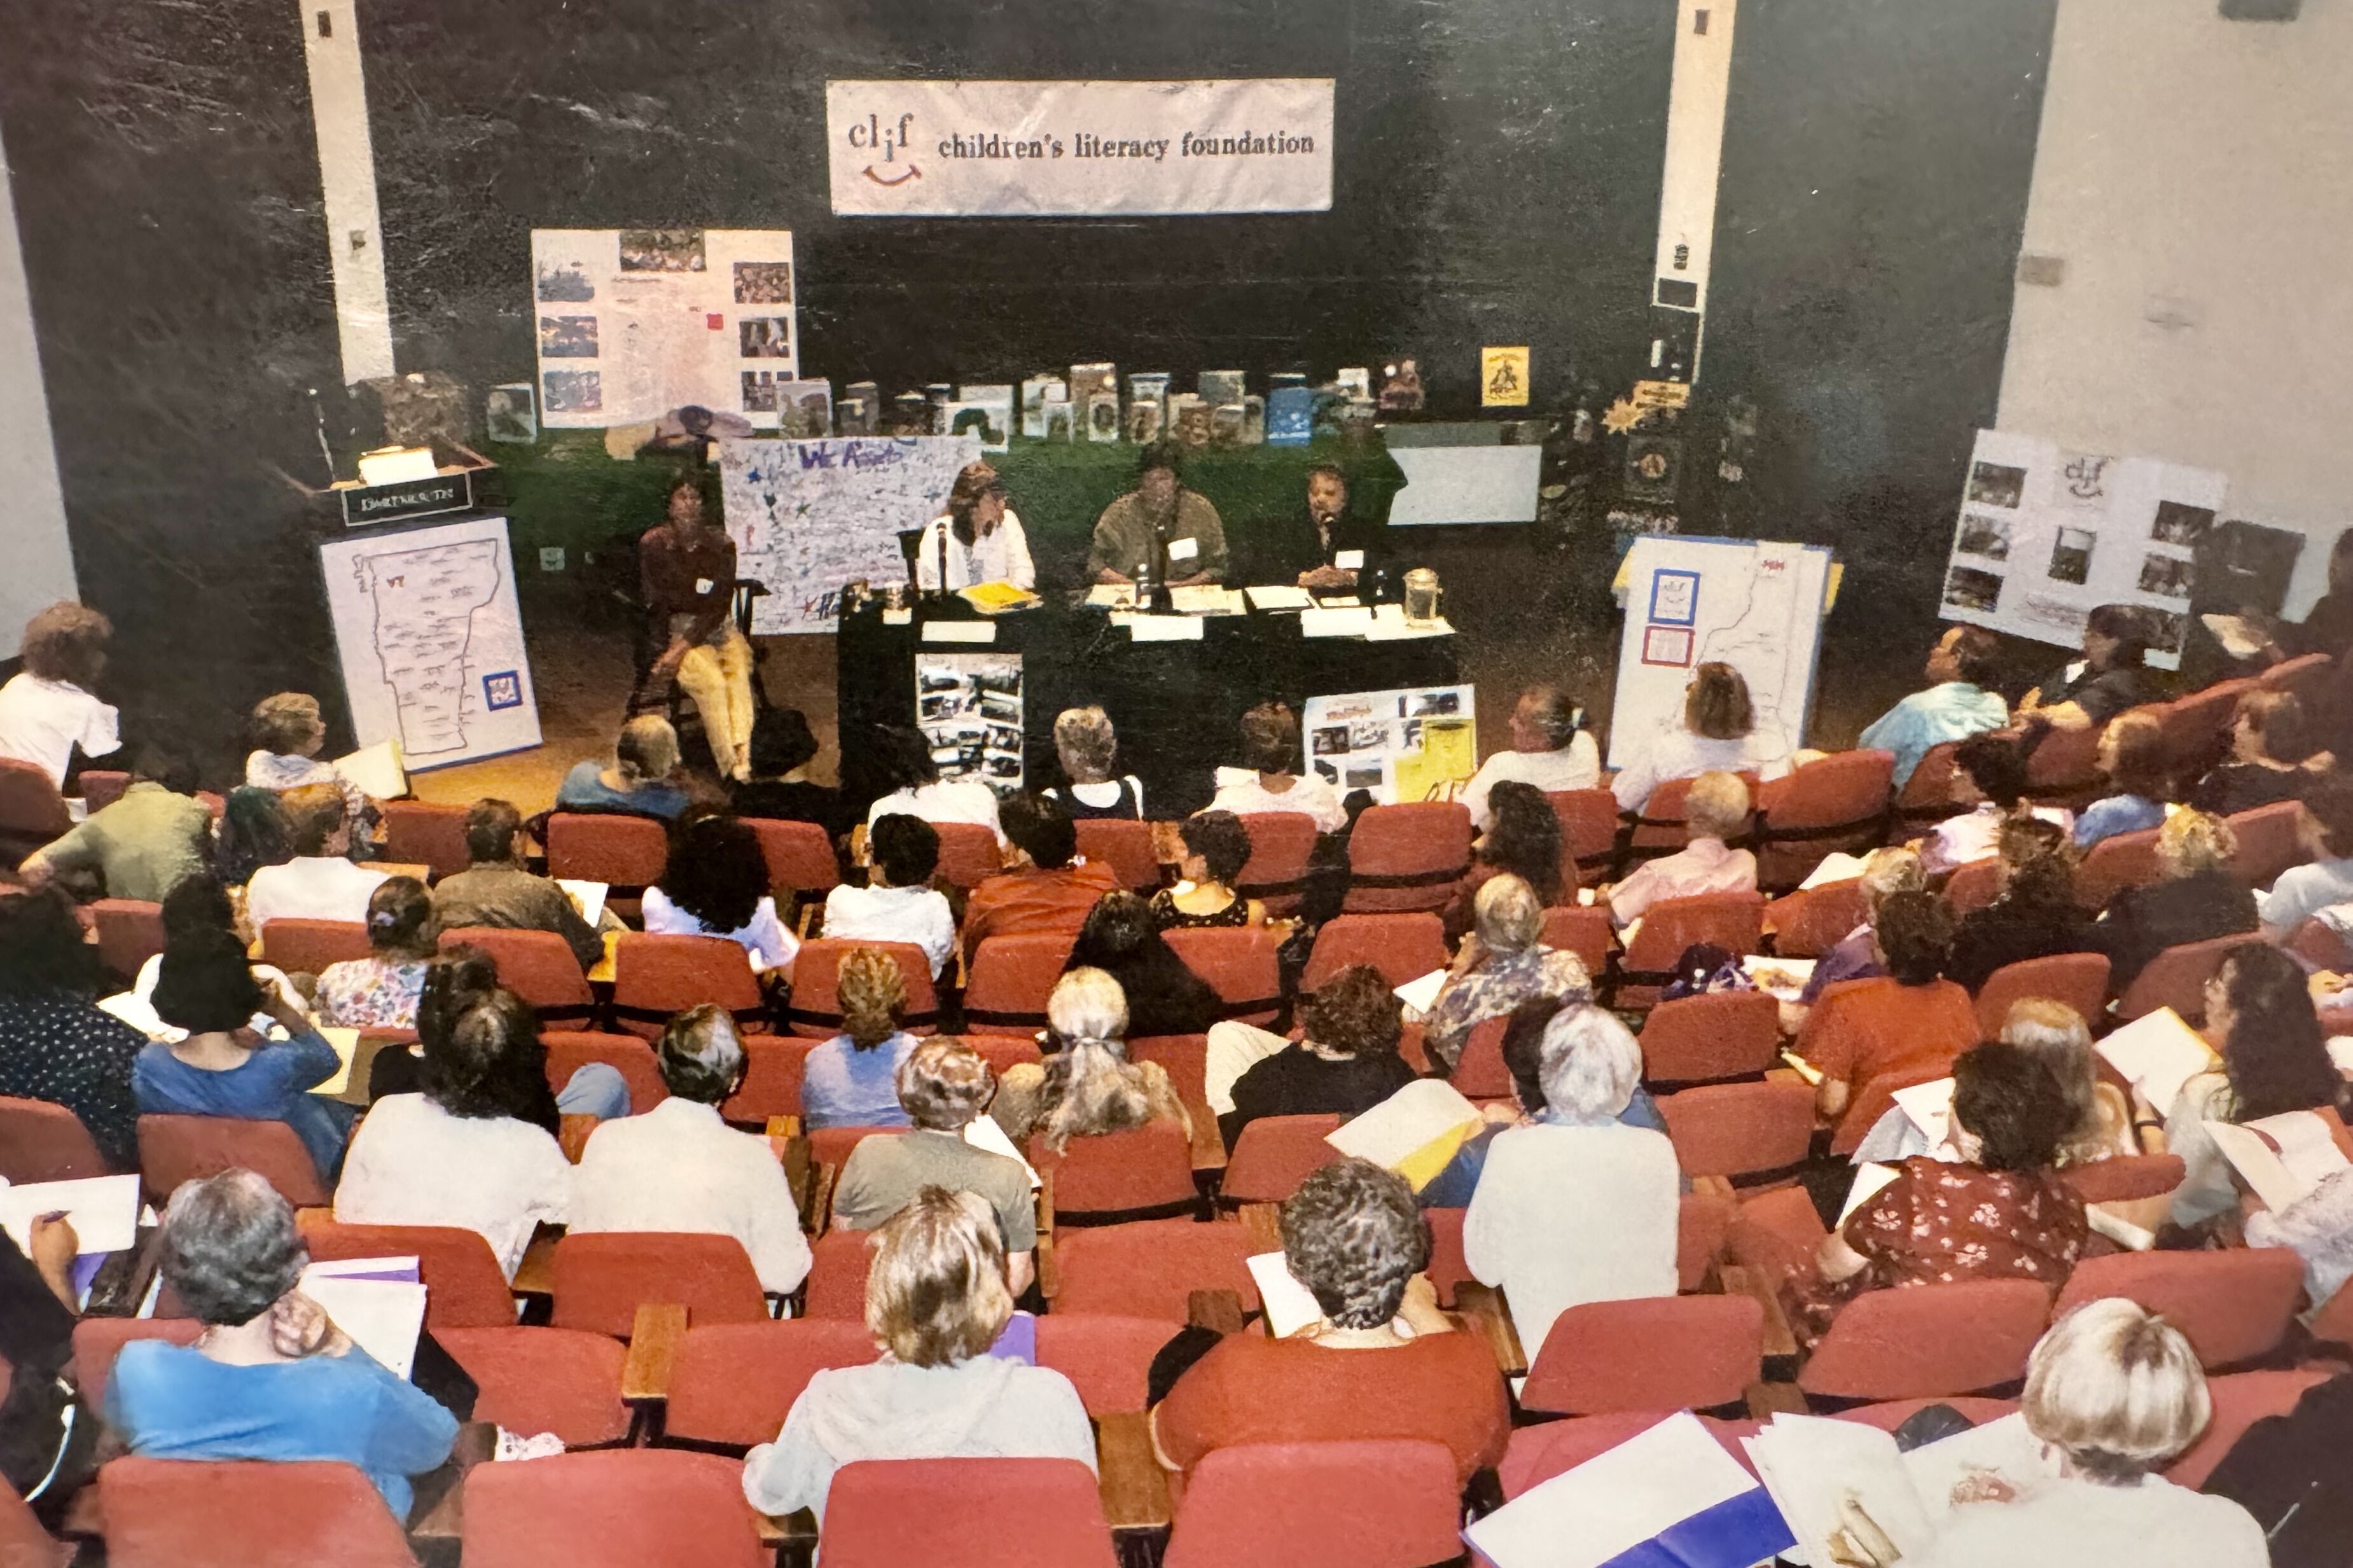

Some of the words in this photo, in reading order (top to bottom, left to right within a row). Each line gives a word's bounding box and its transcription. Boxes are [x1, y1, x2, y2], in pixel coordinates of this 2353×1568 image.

[849, 113, 914, 162] clif
[938, 132, 1064, 158] children's
[1074, 132, 1170, 163] literacy
[1182, 130, 1314, 157] foundation
